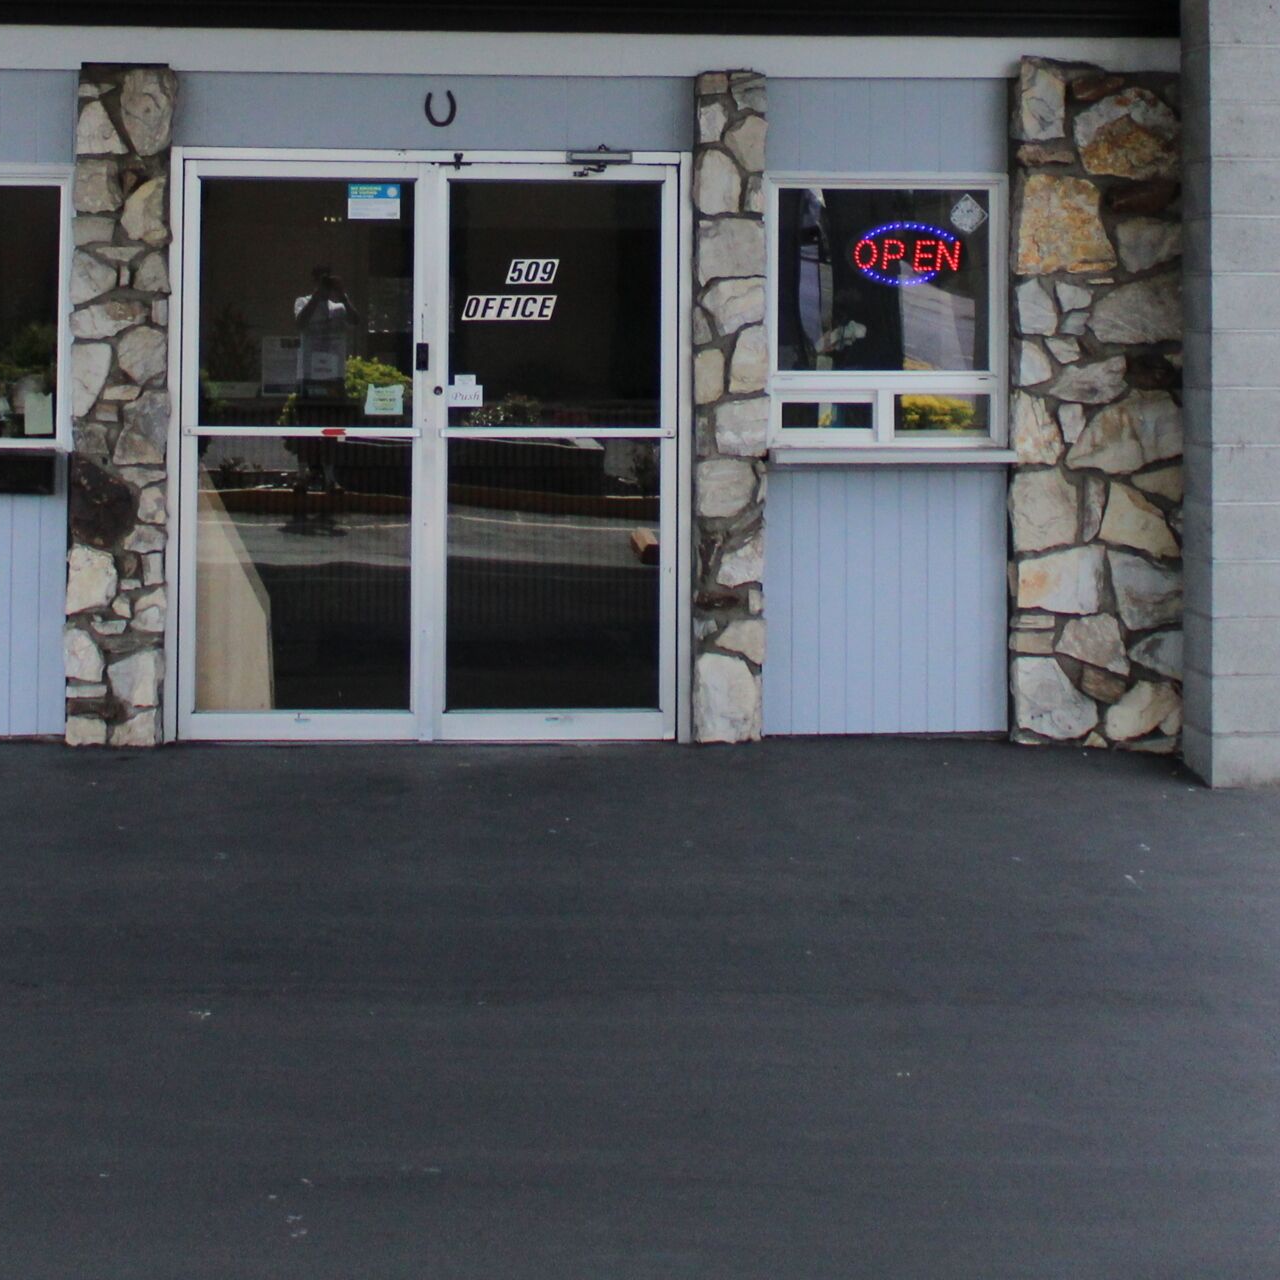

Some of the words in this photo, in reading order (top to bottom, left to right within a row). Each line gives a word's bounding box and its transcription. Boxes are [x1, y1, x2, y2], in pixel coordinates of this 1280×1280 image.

[853, 238, 961, 272] OPEN
[509, 260, 556, 282] 509
[464, 296, 554, 318] OFFICE
